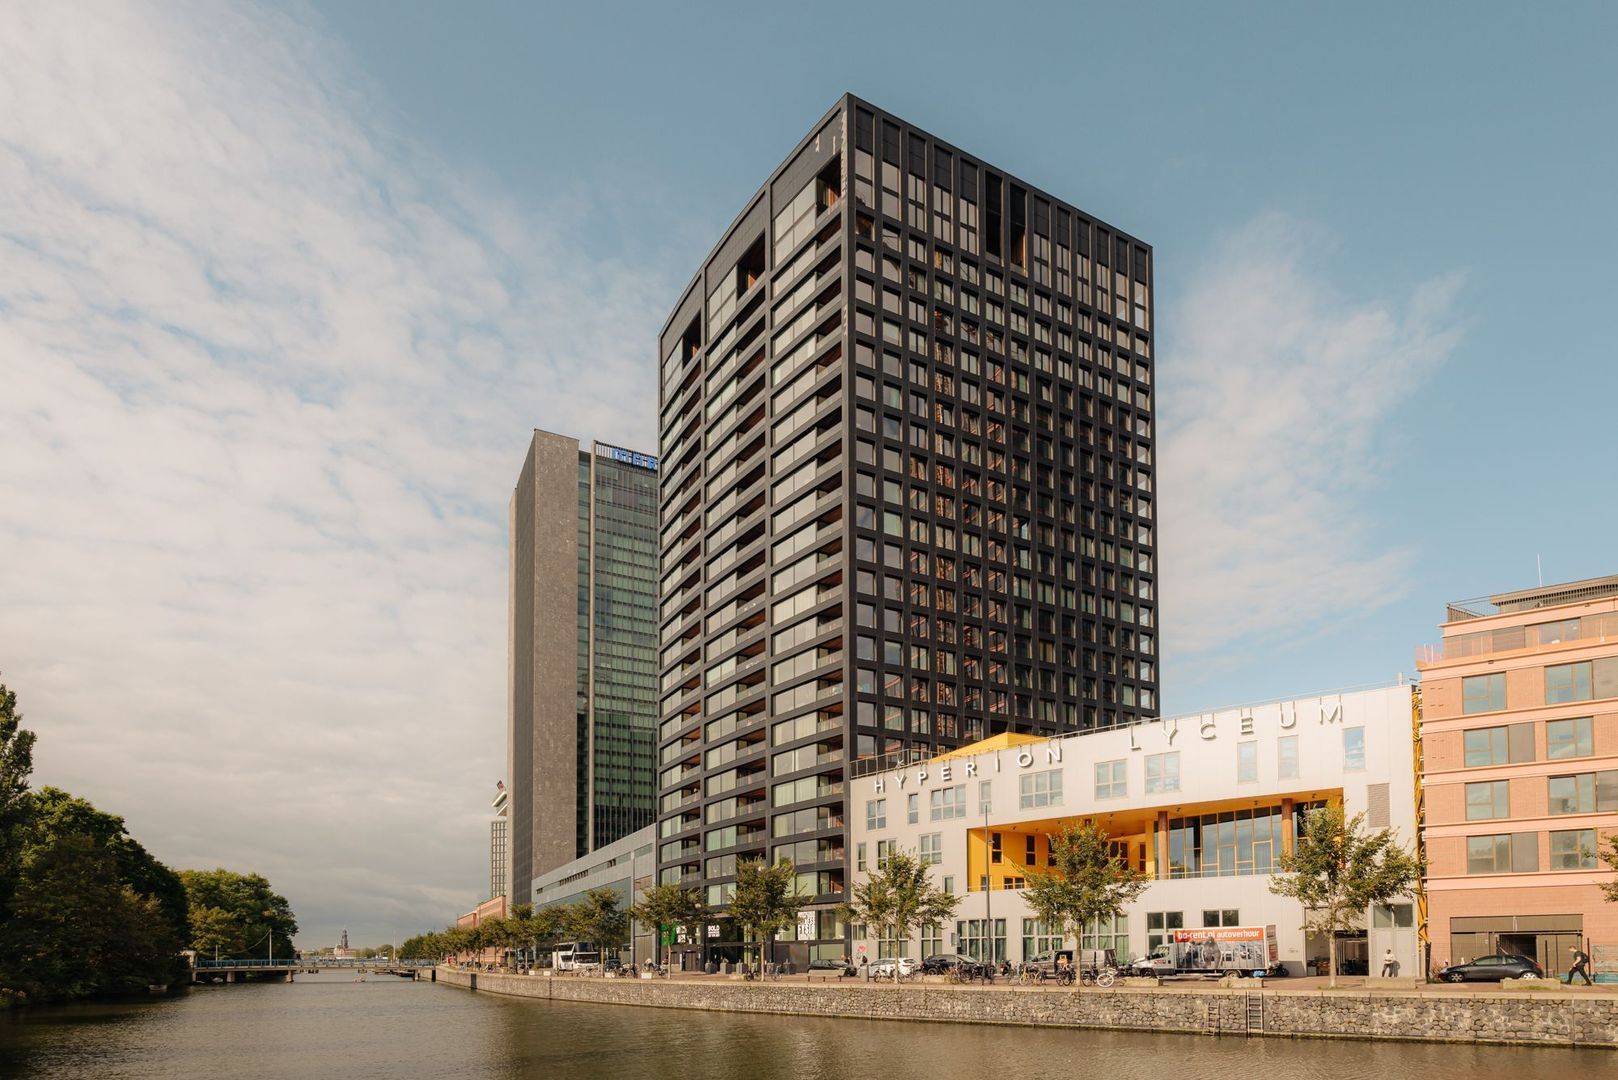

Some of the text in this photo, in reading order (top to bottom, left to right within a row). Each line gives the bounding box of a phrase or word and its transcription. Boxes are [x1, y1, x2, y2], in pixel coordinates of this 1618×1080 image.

[612, 448, 657, 469] MAR
[874, 701, 1343, 793] HYPERION LYCEUM
[1216, 929, 1260, 938] autoverhuur
